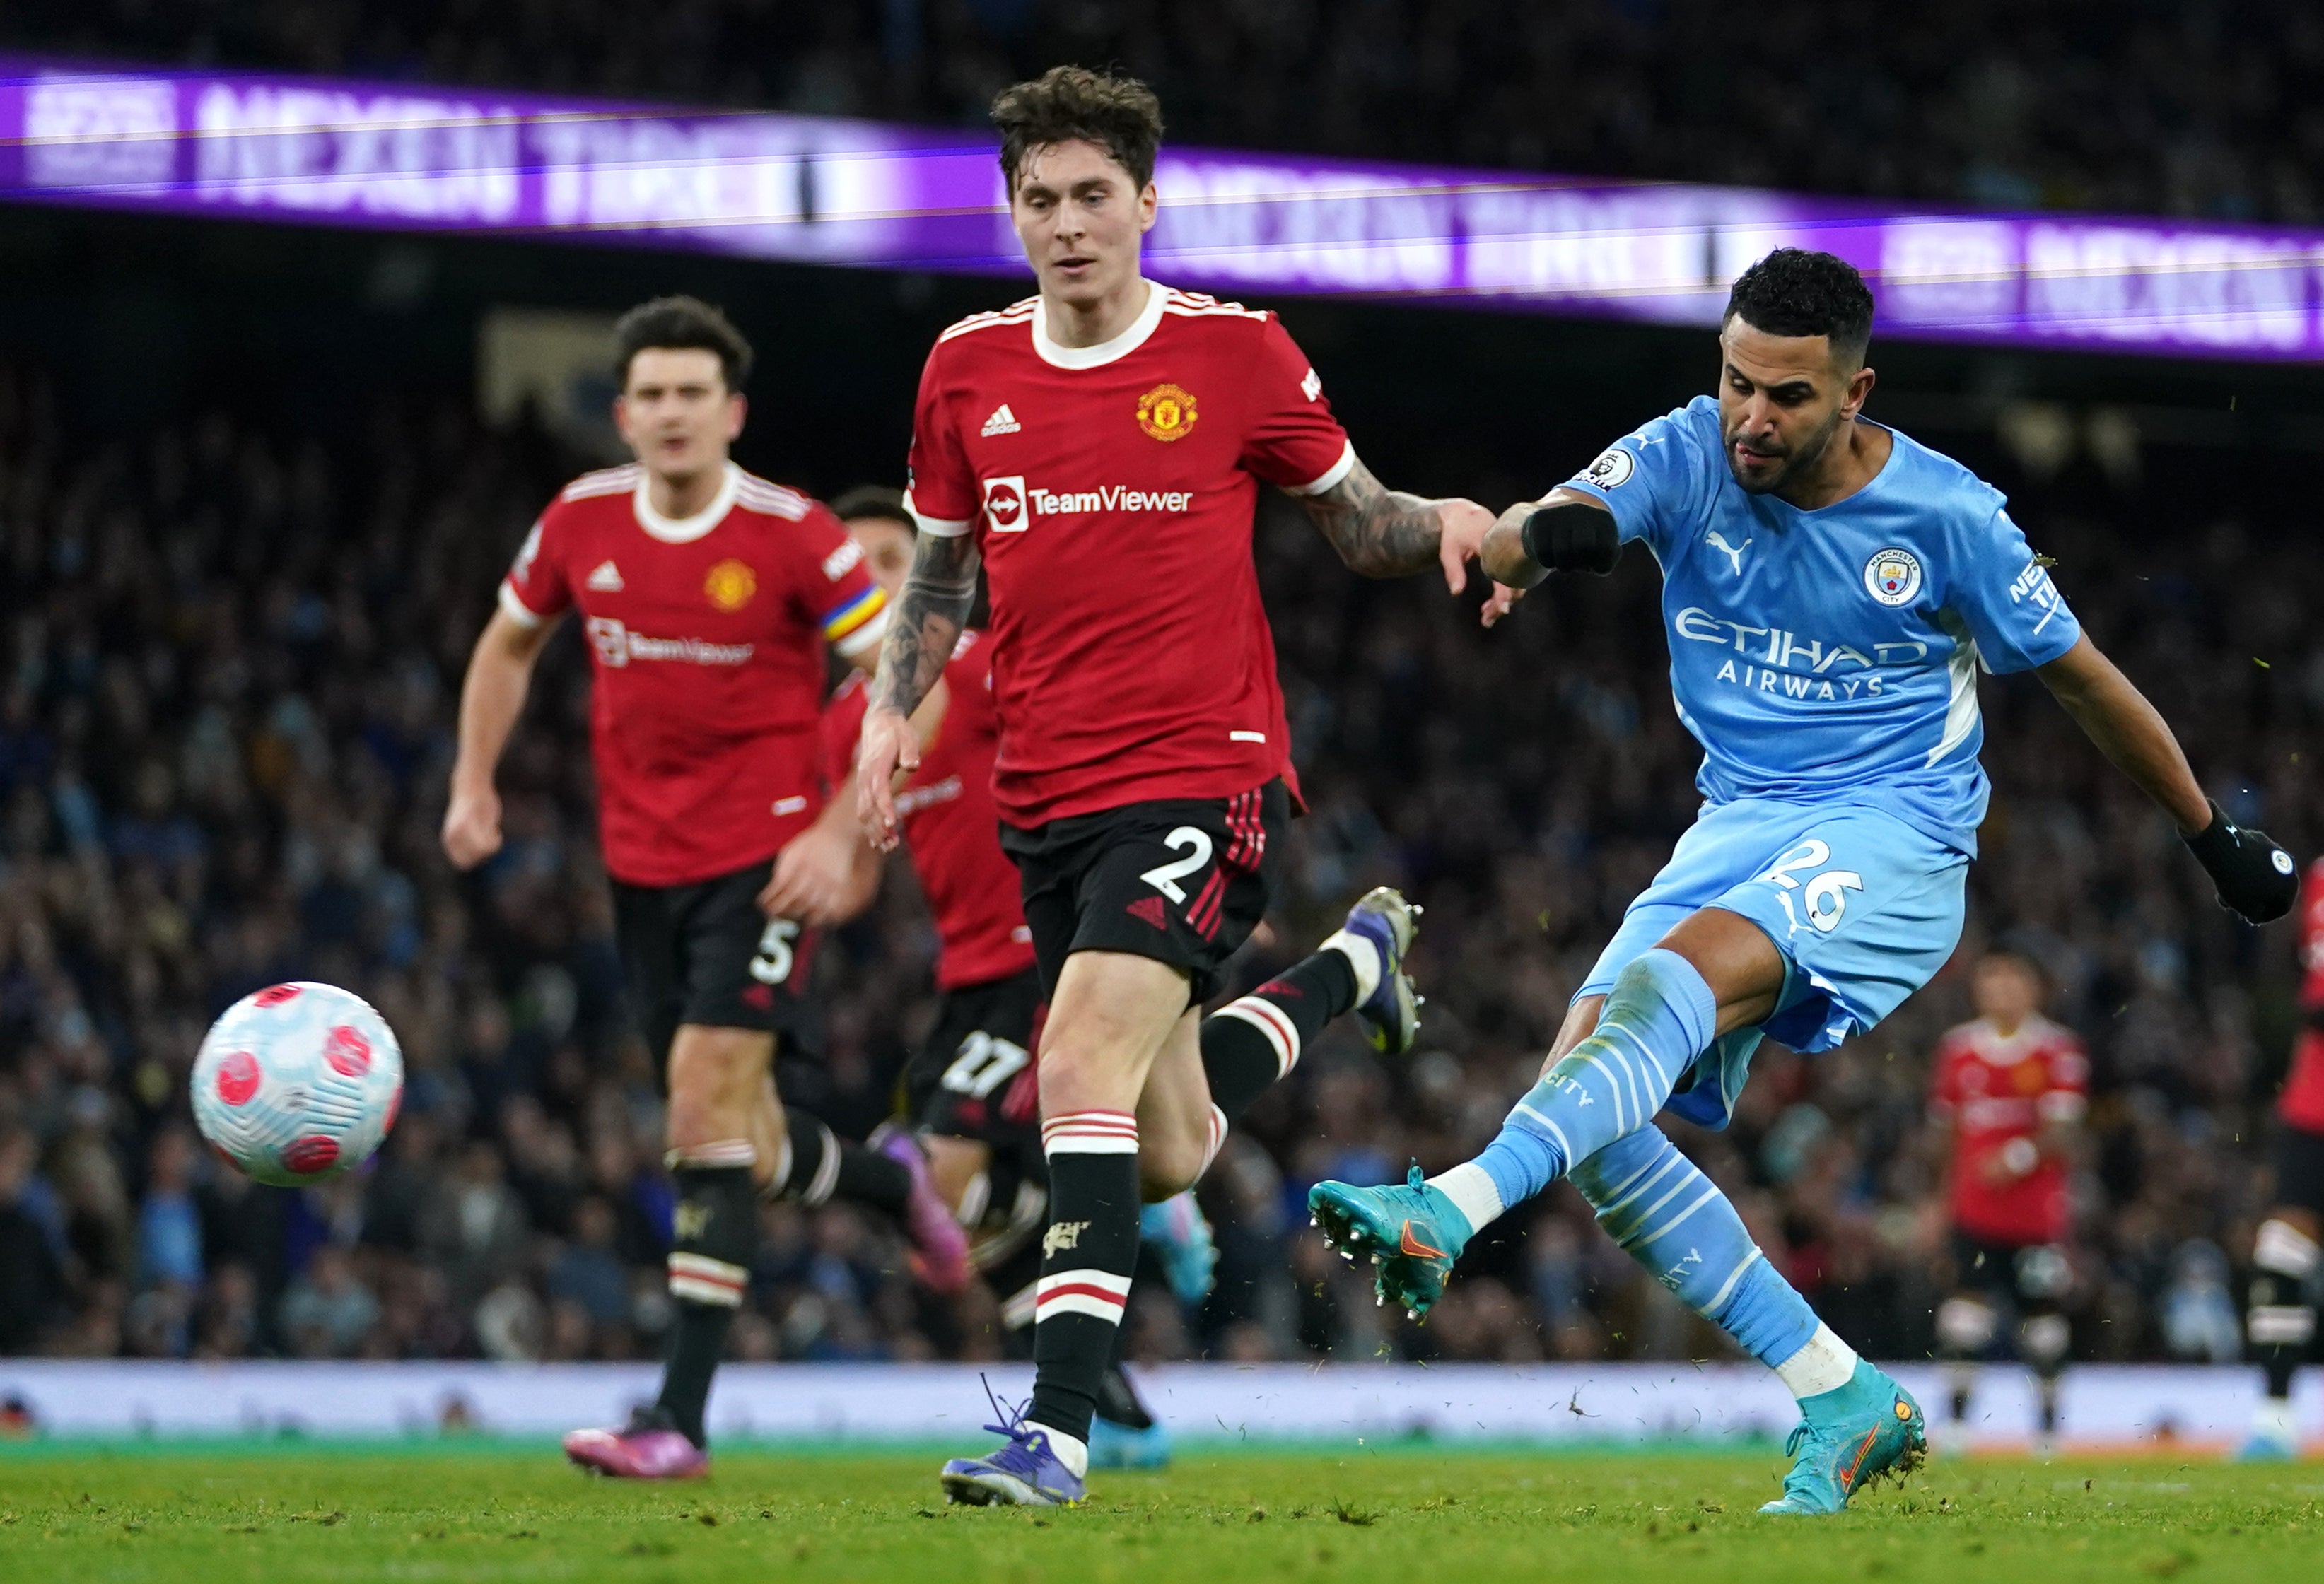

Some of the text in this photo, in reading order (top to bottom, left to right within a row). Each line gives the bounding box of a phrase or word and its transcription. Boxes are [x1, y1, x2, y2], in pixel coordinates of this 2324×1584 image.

[1028, 485, 1193, 515] TeamViewer
[1870, 551, 1918, 572] MANCHESTER
[1675, 606, 1927, 674] ETIHAD
[1716, 659, 1883, 701] AIRWAYS
[1139, 826, 1213, 906] 2
[1749, 839, 1864, 933] 26
[749, 919, 800, 985] 5
[940, 1029, 1031, 1100] 27
[1544, 1072, 1594, 1108] CITY
